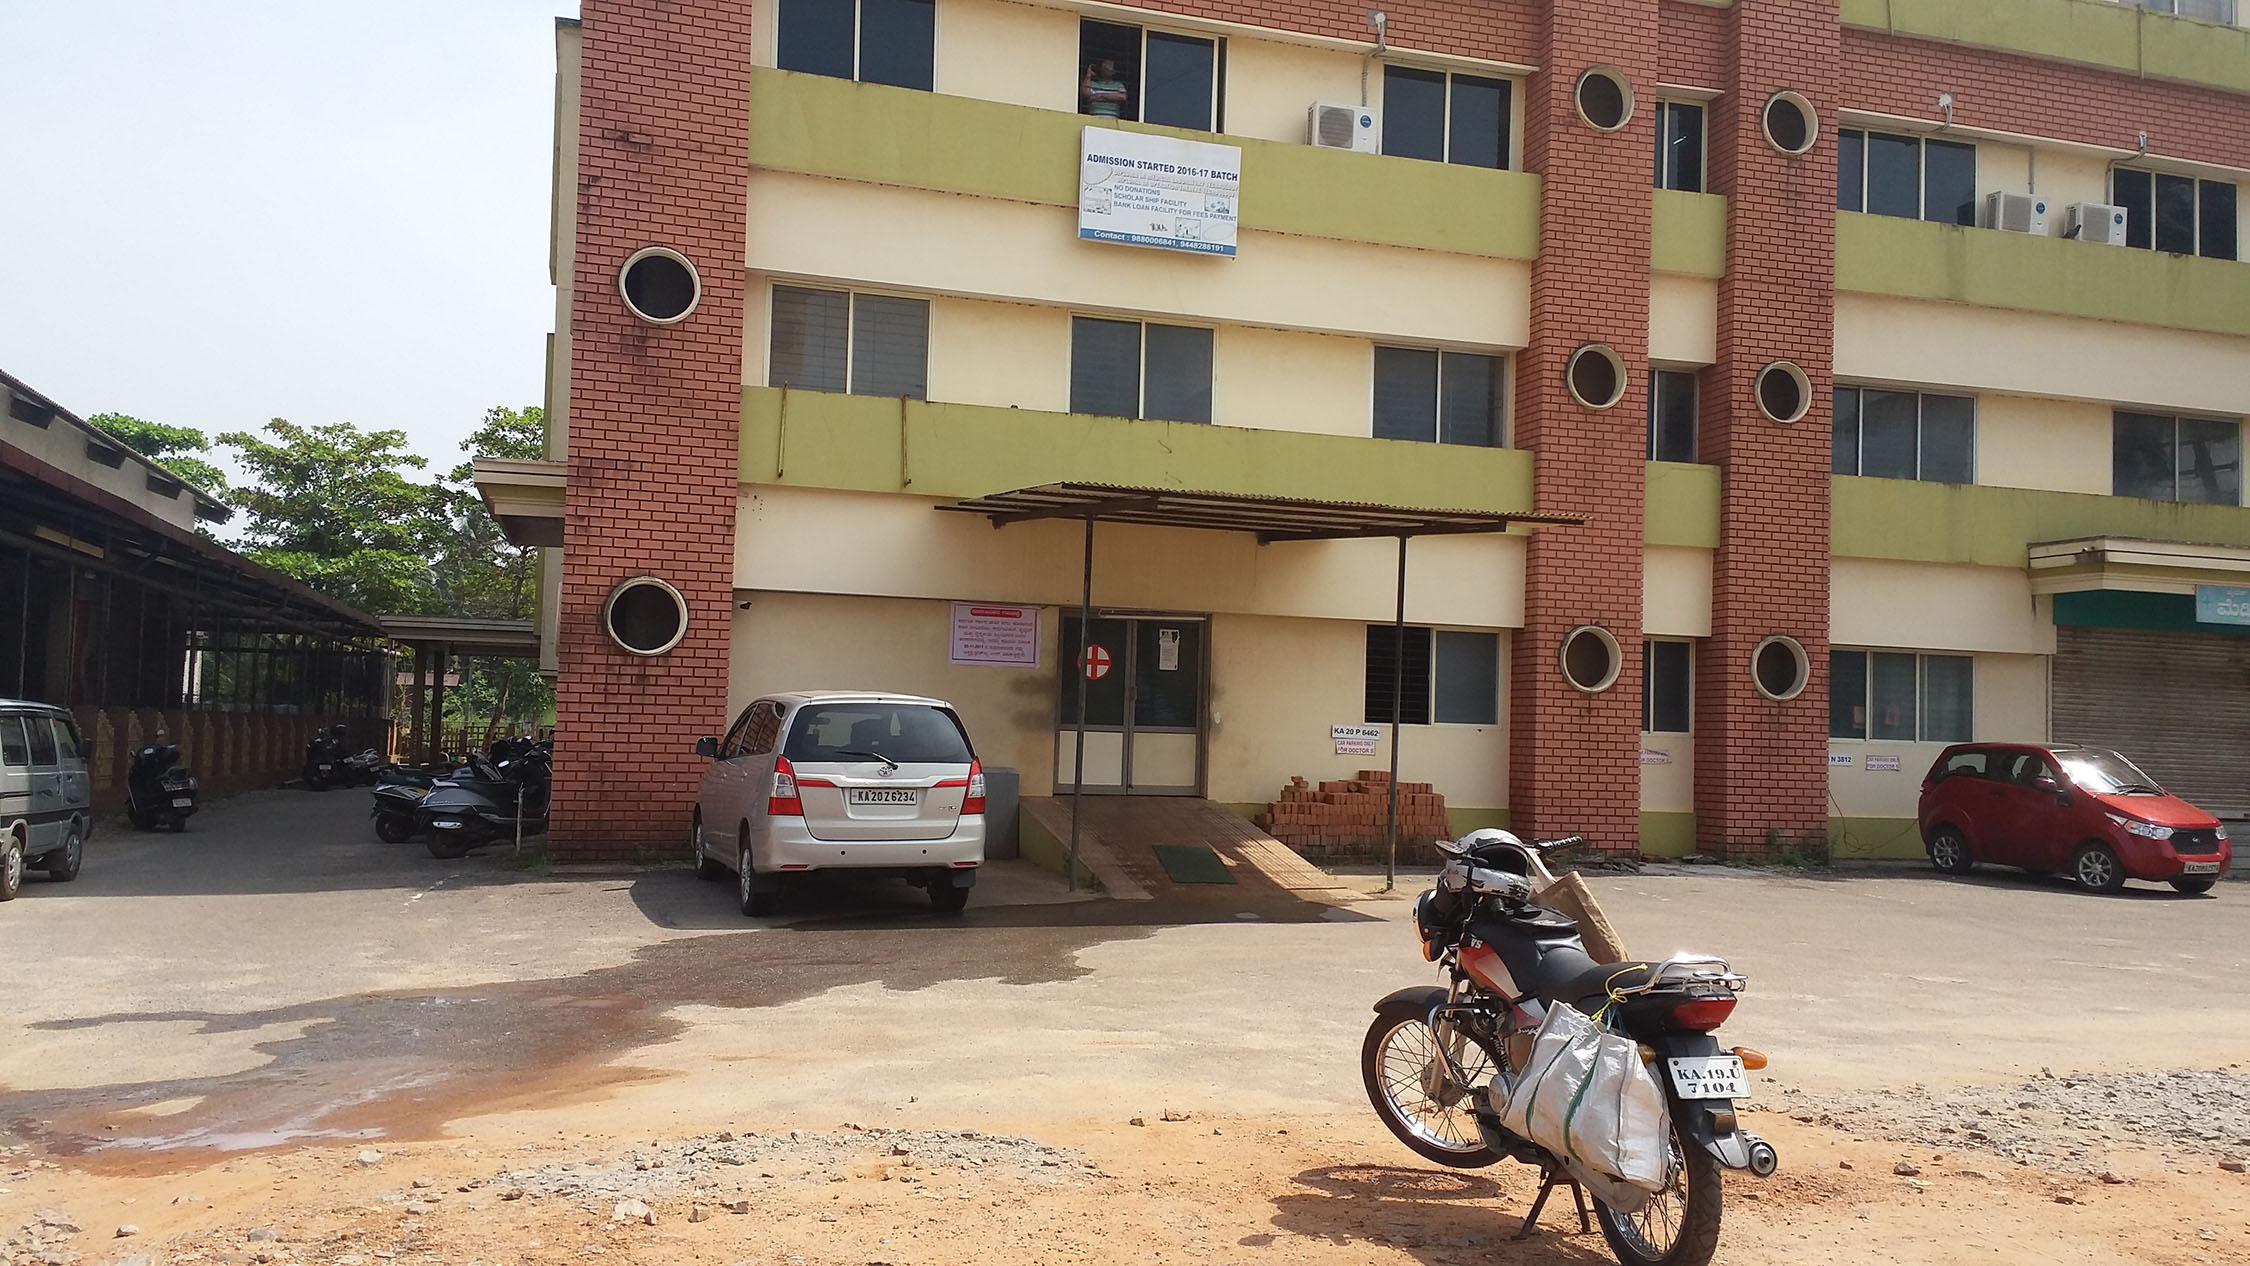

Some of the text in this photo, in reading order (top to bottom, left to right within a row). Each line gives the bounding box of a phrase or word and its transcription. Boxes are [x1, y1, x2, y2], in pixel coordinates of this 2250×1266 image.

[1087, 153, 1135, 168] ADMISSION
[1137, 160, 1175, 174] STARTED
[1177, 166, 1209, 178] 2016-17
[1210, 170, 1238, 182] BATCH
[1125, 185, 1161, 196] DONATIONS
[1113, 192, 1188, 207] SCHOLAR SHIP FACILITY
[1113, 200, 1237, 222] BANK LOAN FACILITY FOR FEES PAYMENT
[1094, 230, 1125, 241] Contact
[1334, 727, 1344, 735] KA
[1361, 729, 1379, 737] 6462
[1676, 1068, 1741, 1081] KA.19.U
[1687, 1081, 1737, 1094] 7104
